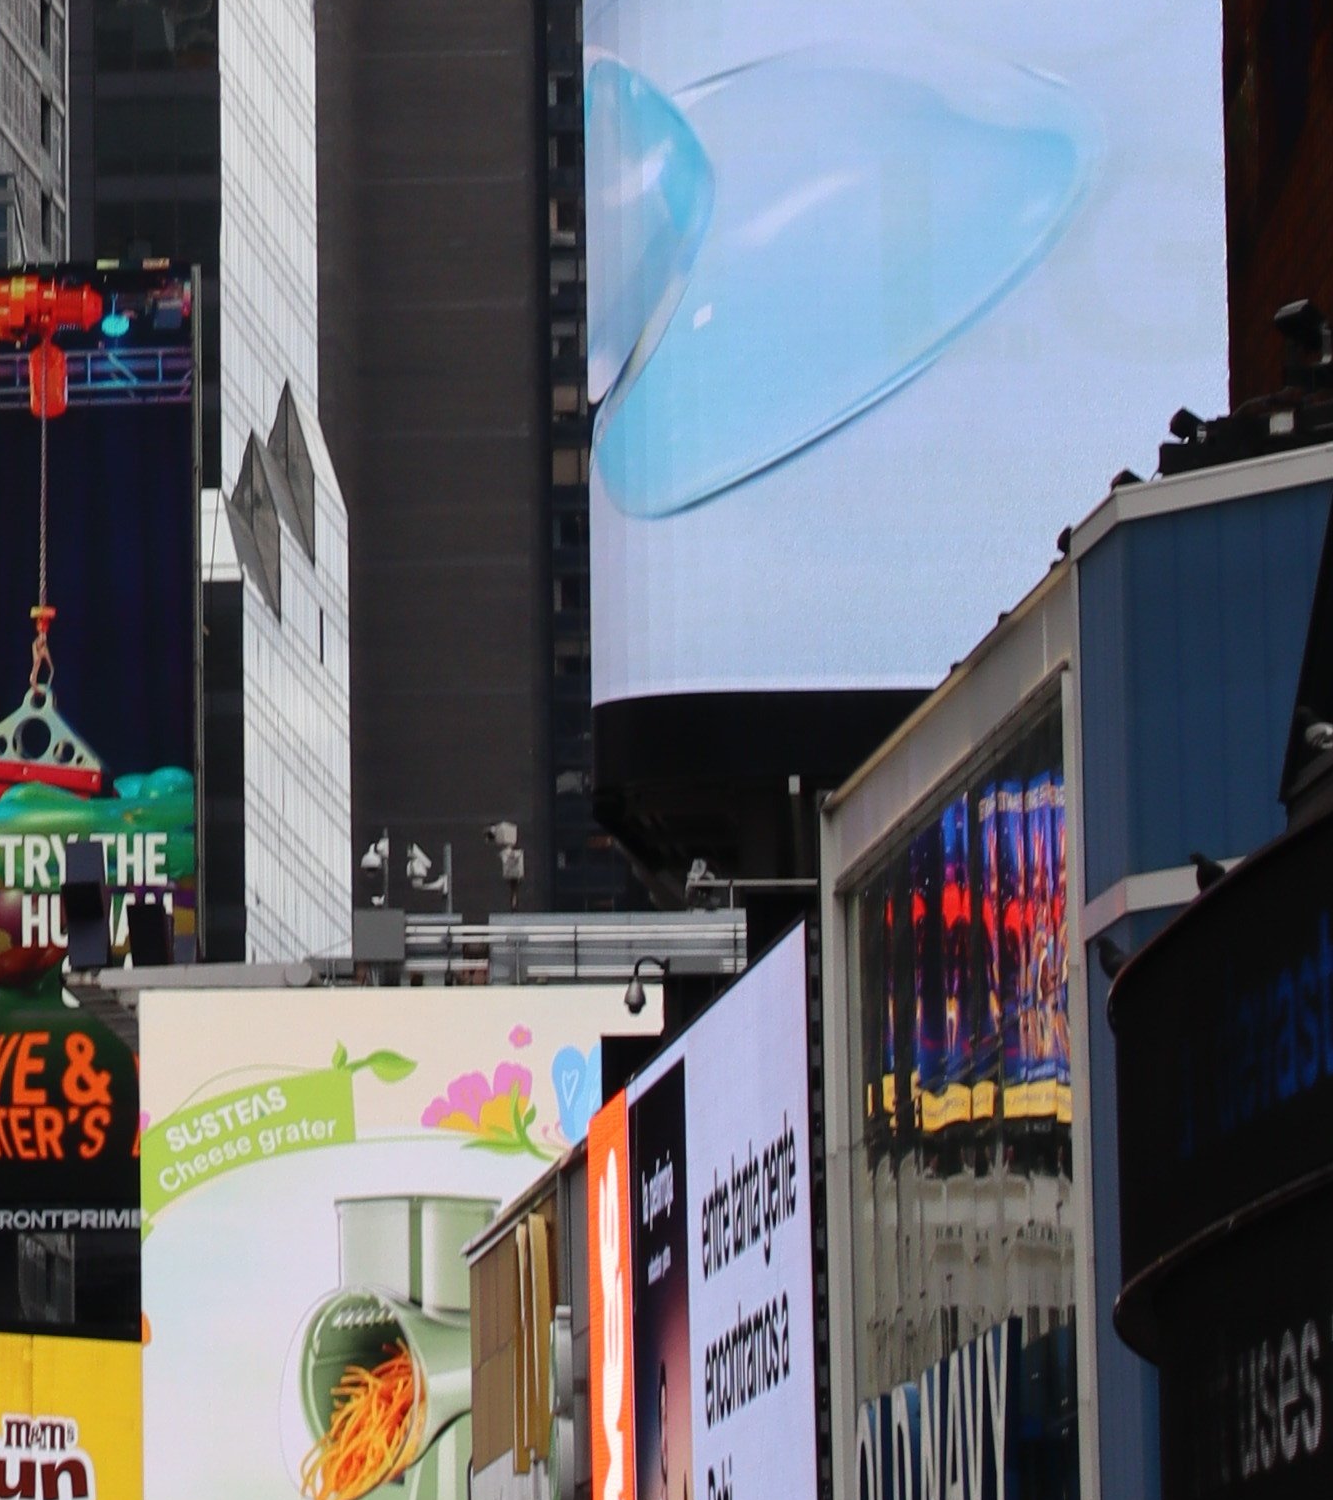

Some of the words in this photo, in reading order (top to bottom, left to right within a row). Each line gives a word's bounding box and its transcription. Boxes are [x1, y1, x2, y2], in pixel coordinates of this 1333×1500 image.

[62, 1032, 112, 1106] &
[159, 1136, 252, 1192] Cheese
[258, 1118, 337, 1156] grater
